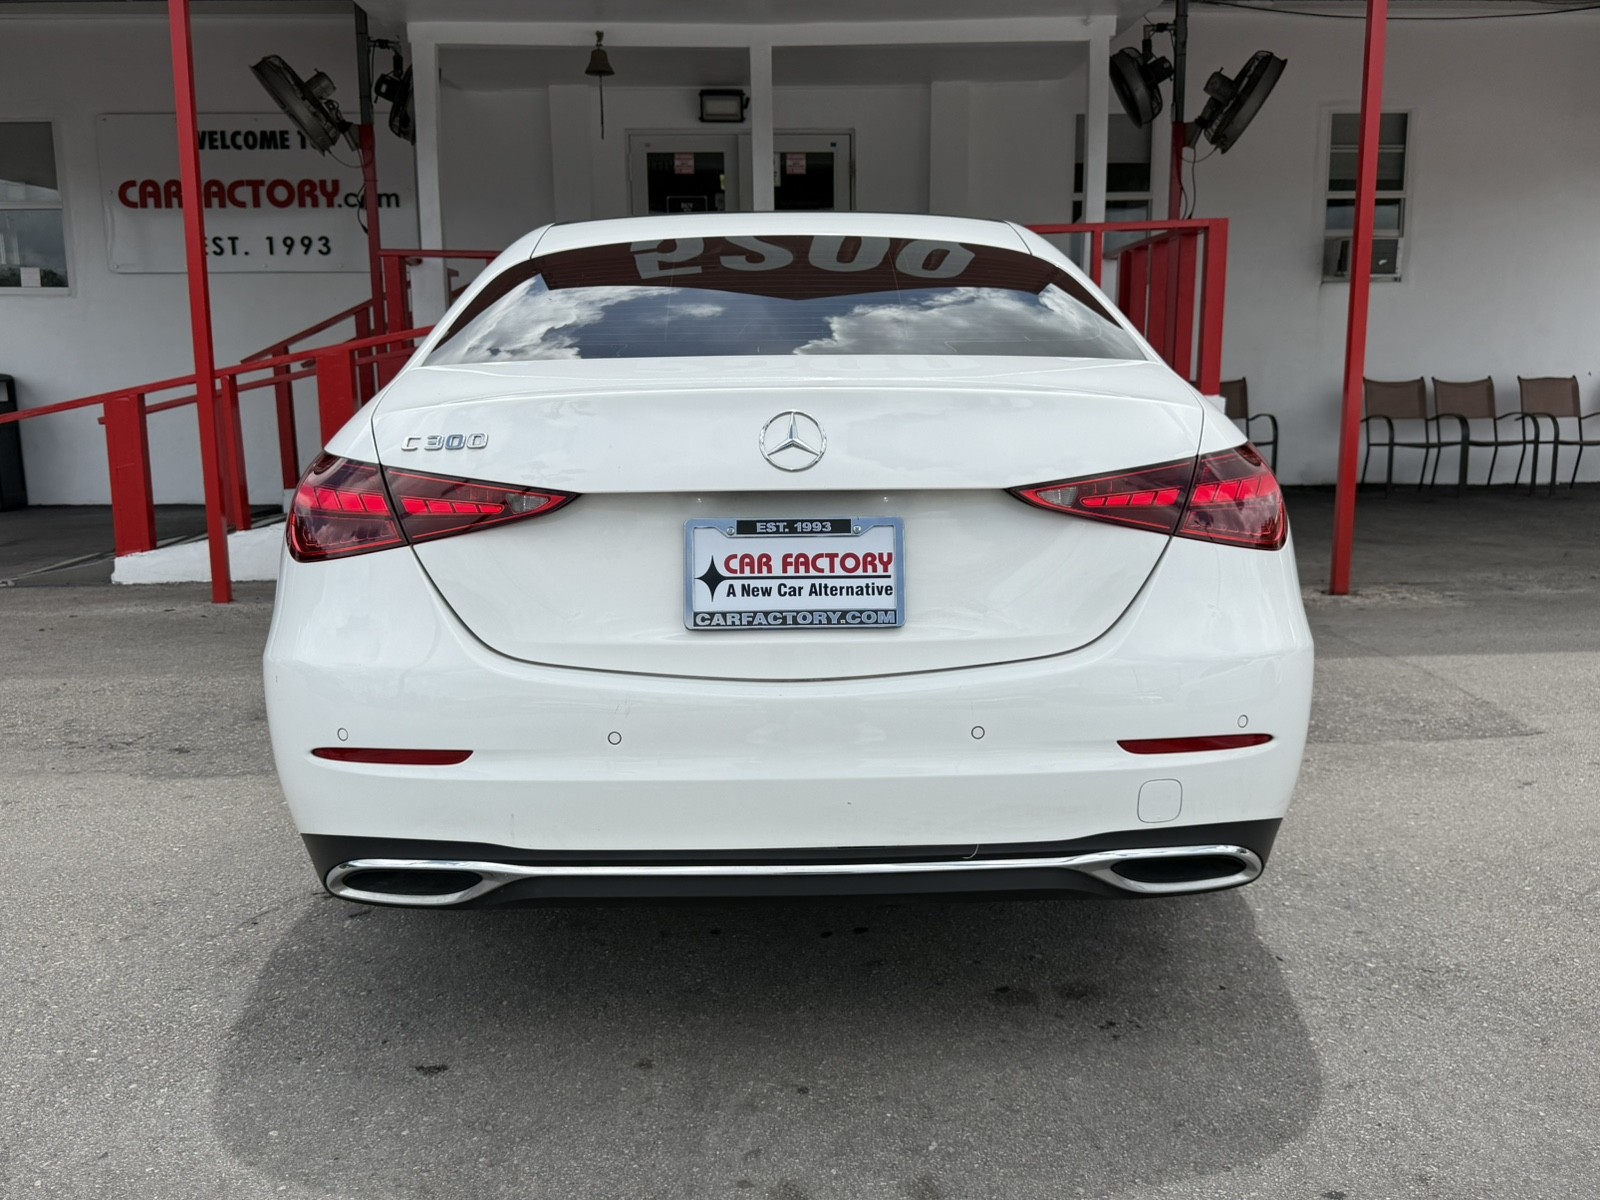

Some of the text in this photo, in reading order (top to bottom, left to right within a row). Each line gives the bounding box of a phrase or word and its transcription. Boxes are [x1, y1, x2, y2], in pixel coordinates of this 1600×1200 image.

[117, 178, 401, 209] CARACTORY.cm
[204, 235, 332, 256] ST. 1993
[756, 521, 832, 533] EST. 1993
[723, 552, 893, 574] CAR FACTORY
[726, 582, 894, 598] A New Car Alternative
[695, 610, 897, 627] CARFACTORY.COM
